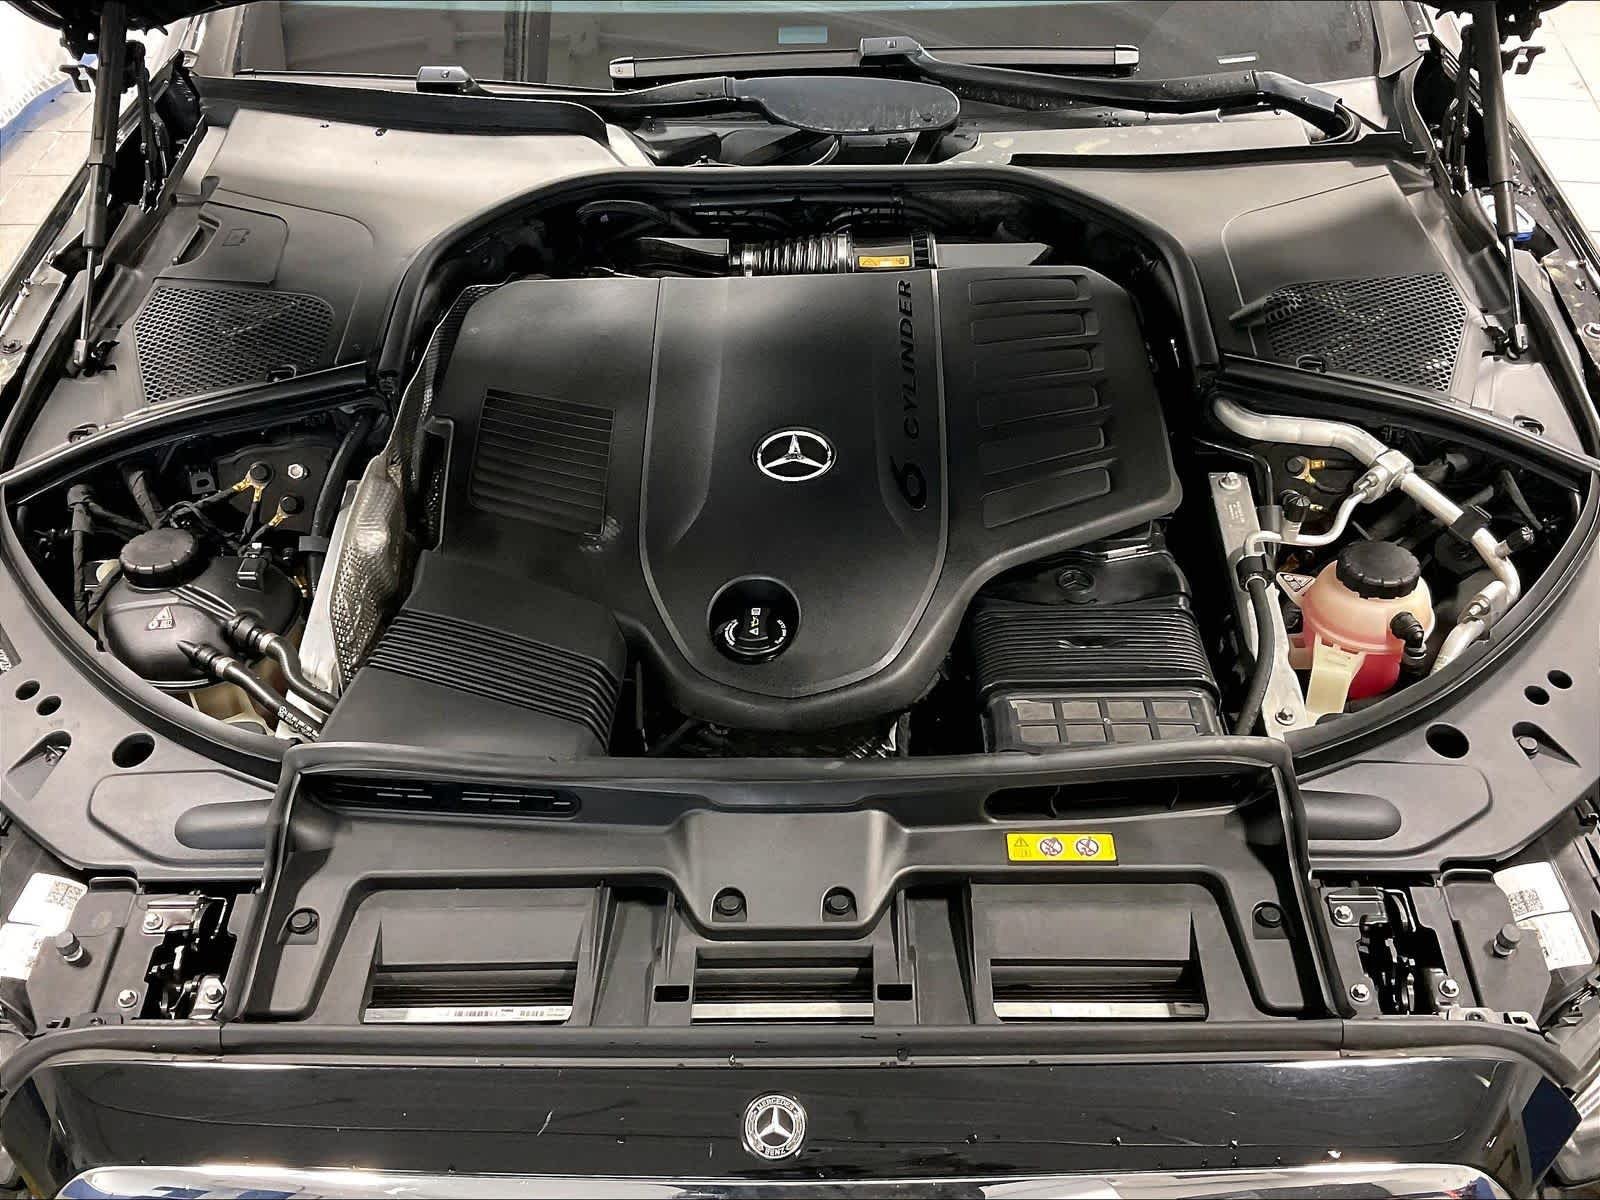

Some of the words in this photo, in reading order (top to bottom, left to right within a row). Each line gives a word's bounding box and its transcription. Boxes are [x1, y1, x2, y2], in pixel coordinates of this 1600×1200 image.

[897, 279, 920, 440] CYLINDER
[889, 455, 927, 511] 6
[757, 1098, 795, 1111] MERCEDES
[764, 1146, 786, 1157] BENZ
